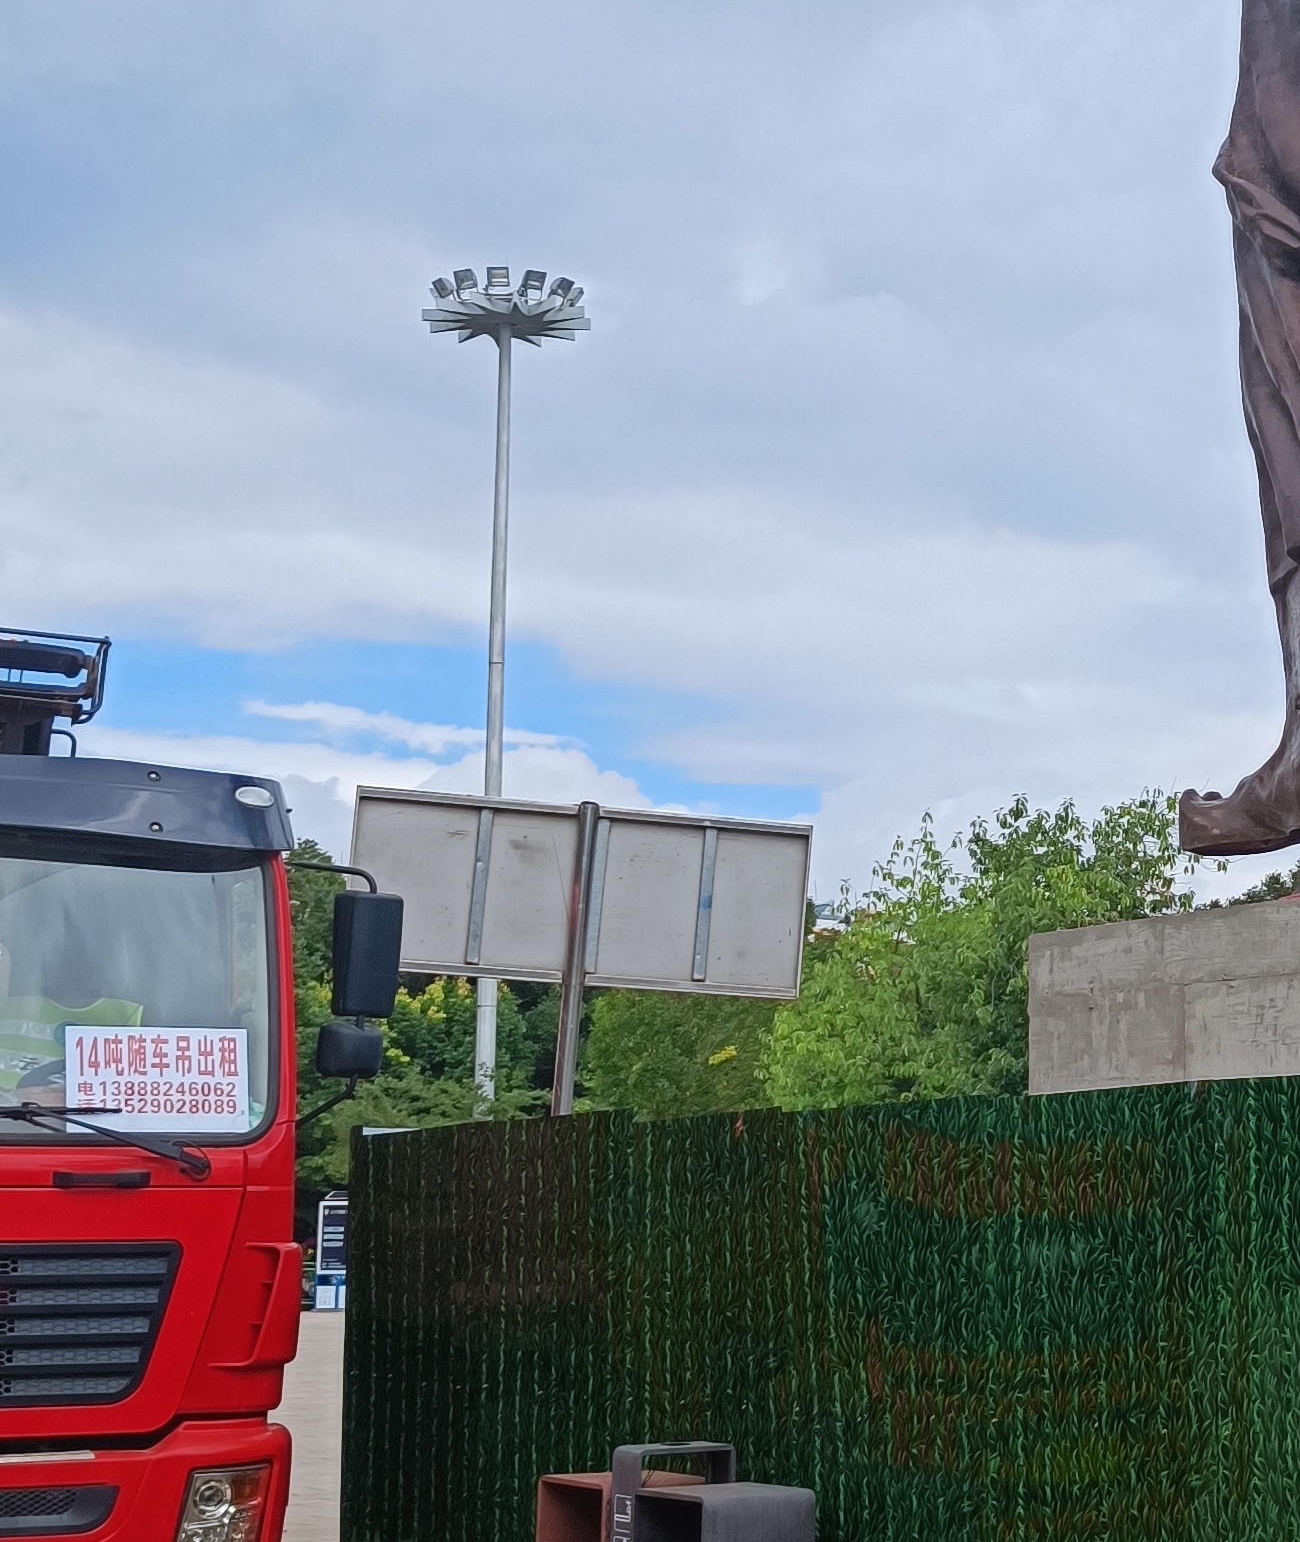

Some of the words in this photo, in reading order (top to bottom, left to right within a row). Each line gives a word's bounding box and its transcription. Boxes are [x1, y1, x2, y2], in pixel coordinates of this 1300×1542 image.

[76, 1034, 239, 1078] 14吨随车吊出租
